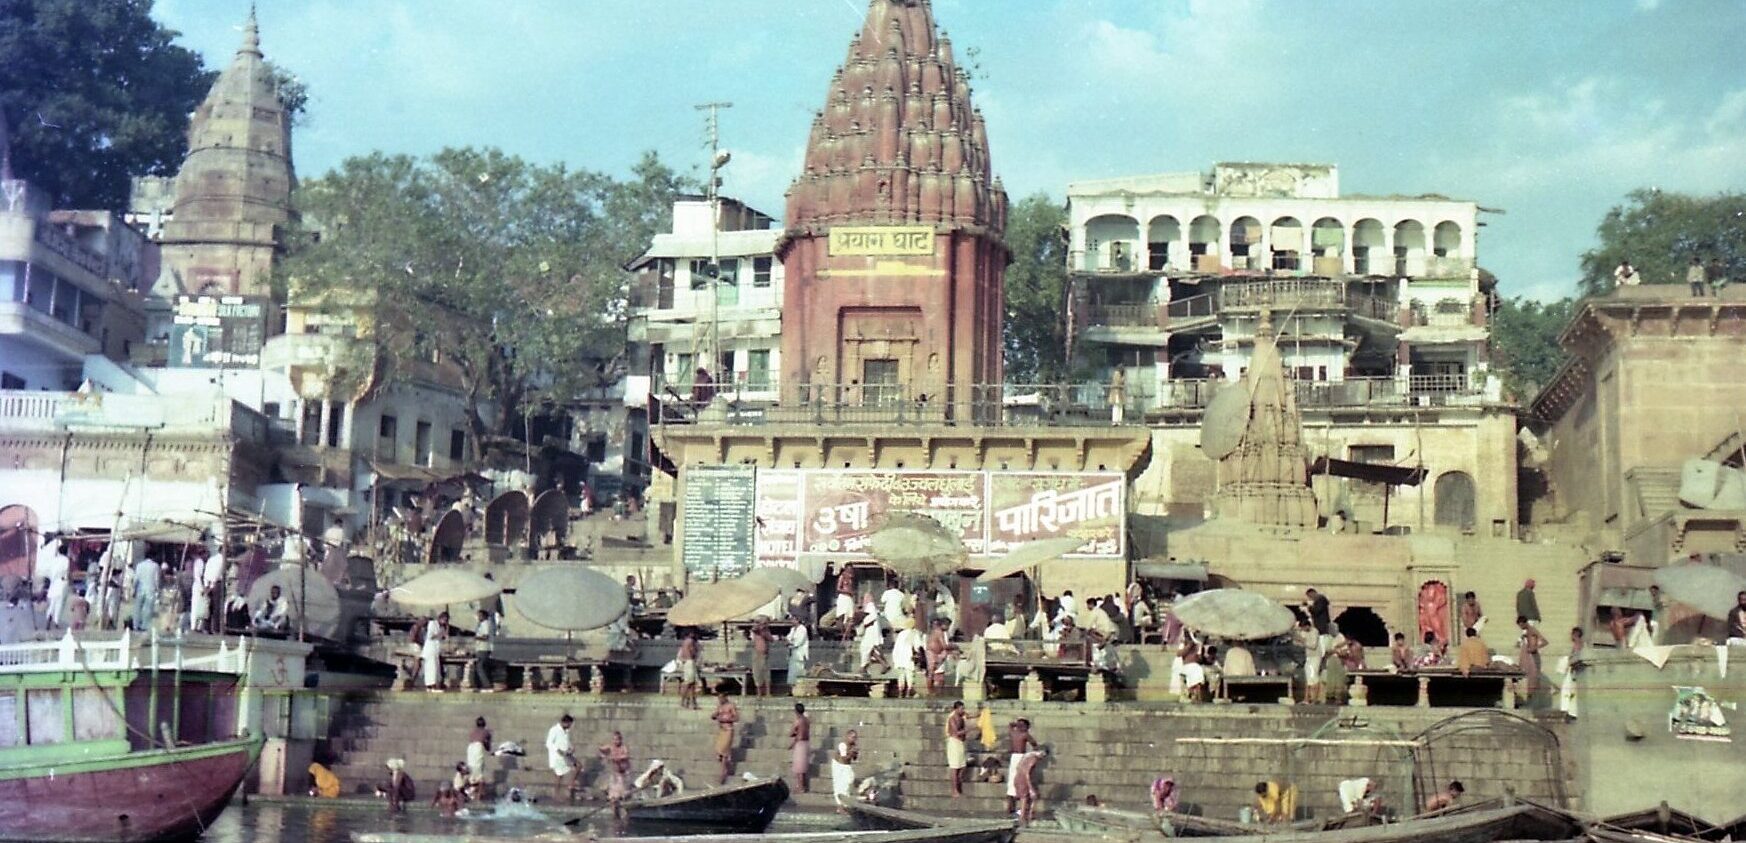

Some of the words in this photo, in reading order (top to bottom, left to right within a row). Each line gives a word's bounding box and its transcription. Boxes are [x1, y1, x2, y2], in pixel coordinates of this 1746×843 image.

[893, 232, 929, 250] घाट
[813, 502, 870, 534] उषा
[994, 480, 1121, 535] पारिजात
[759, 539, 795, 555] HOTEL
